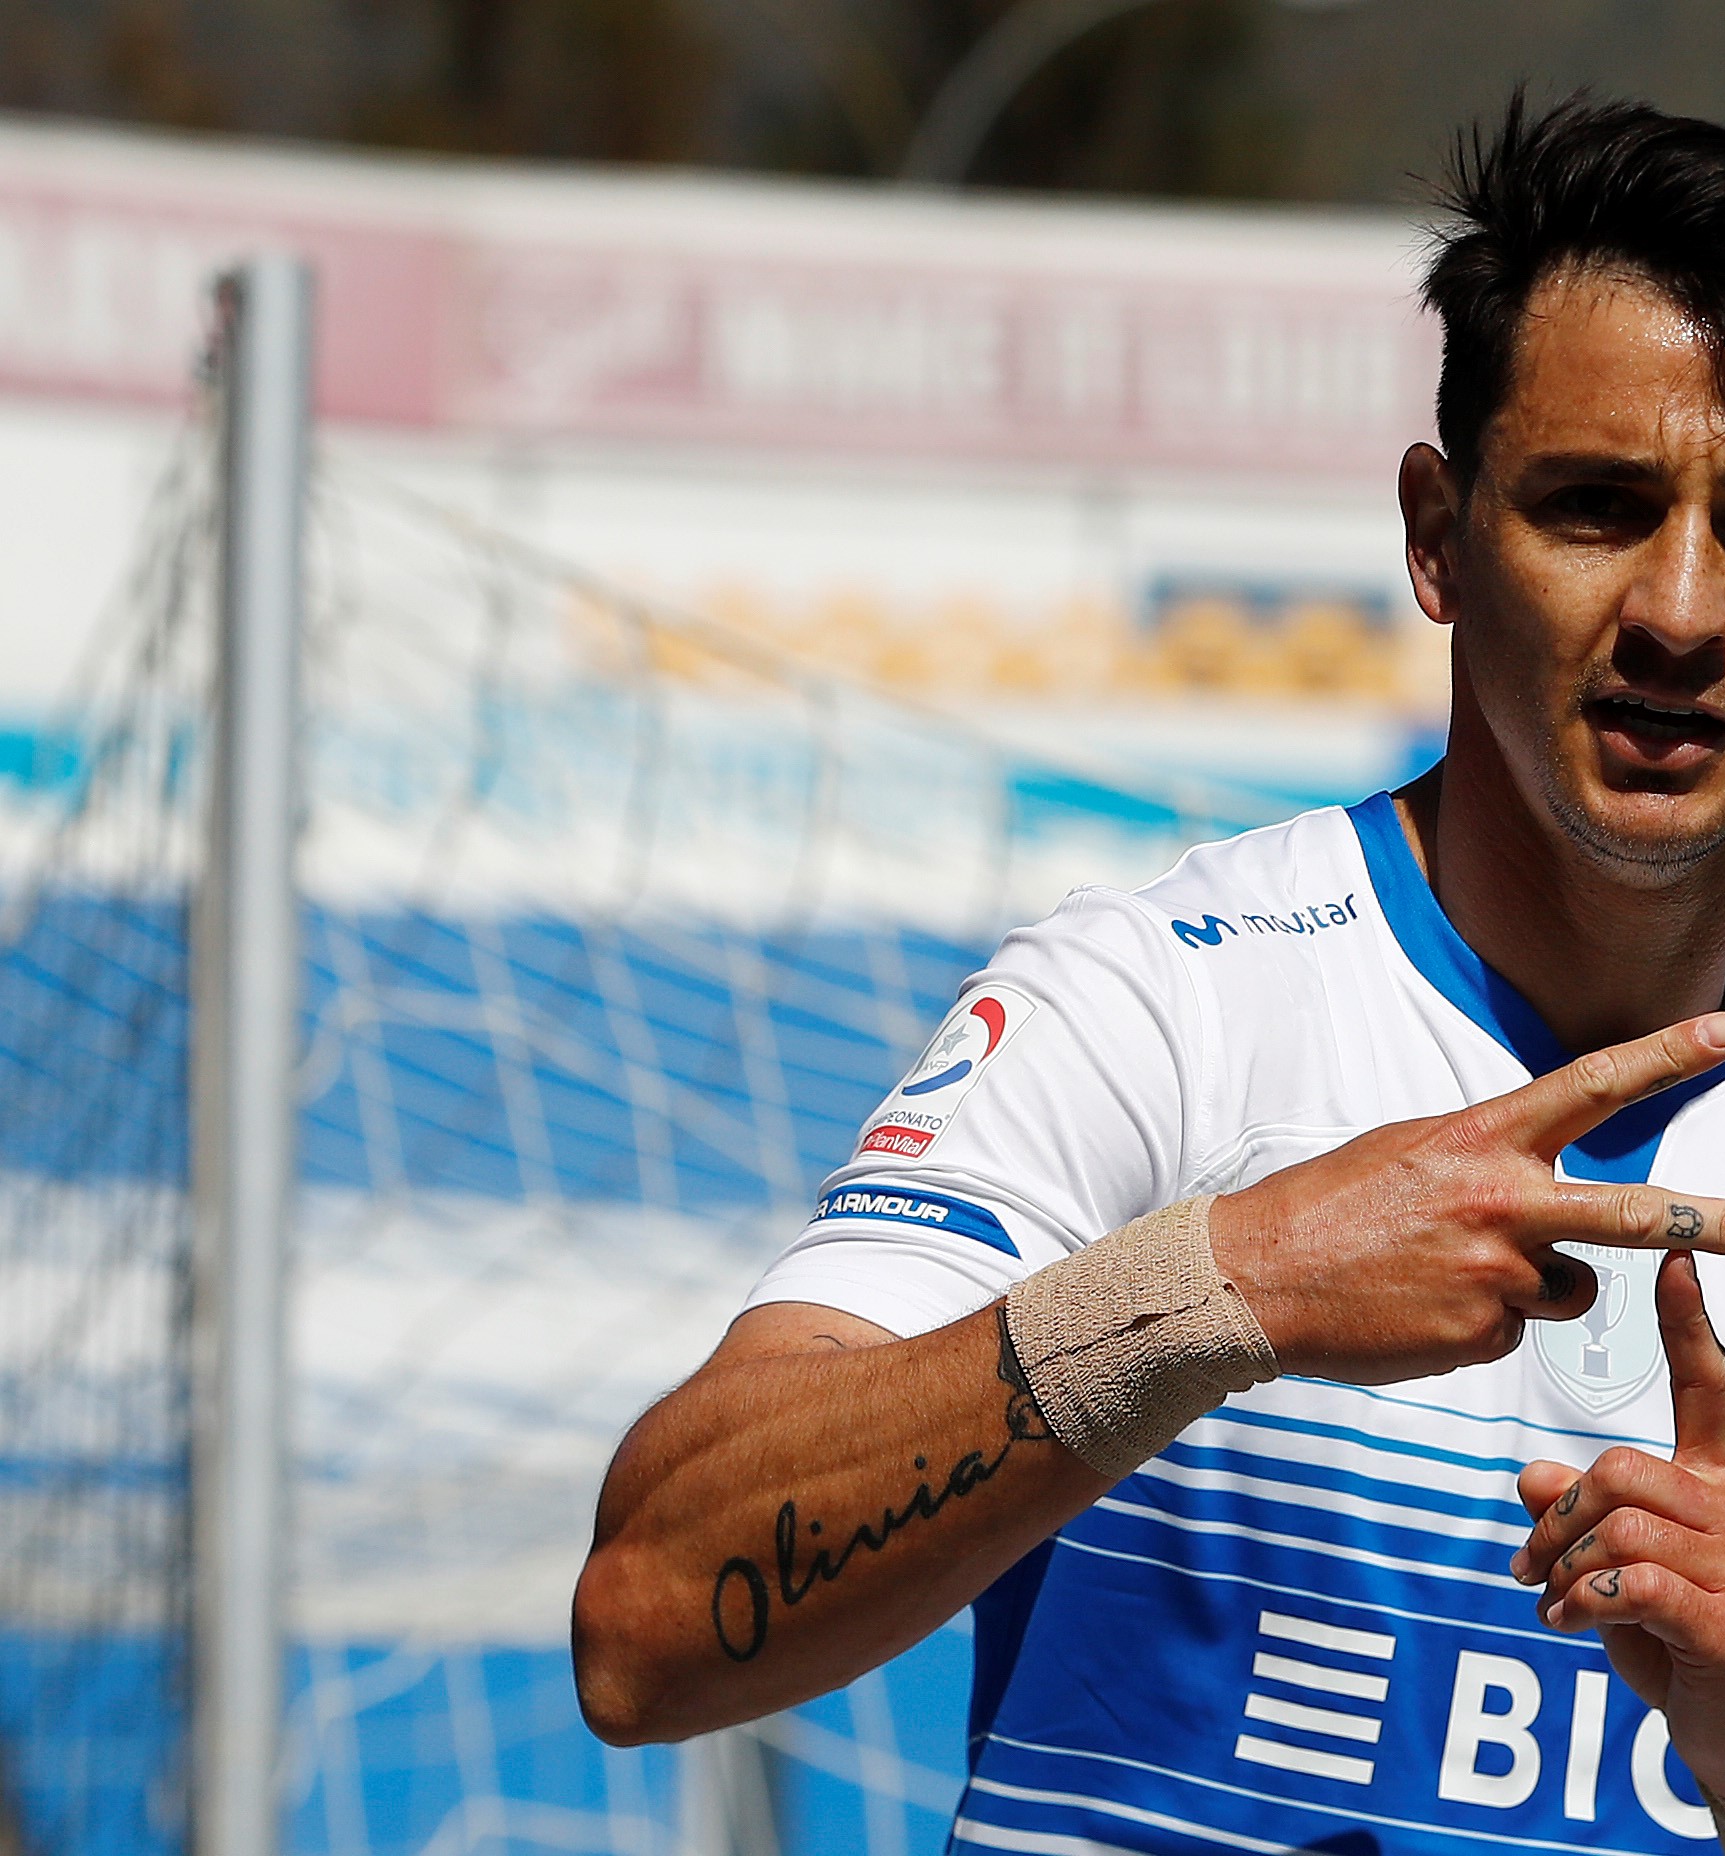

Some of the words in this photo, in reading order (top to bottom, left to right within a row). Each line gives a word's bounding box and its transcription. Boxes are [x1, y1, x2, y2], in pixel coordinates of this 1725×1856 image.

[1241, 893, 1357, 936] movtar
[828, 1193, 949, 1222] ARMOUR
[711, 1449, 1010, 1663] Olivia
